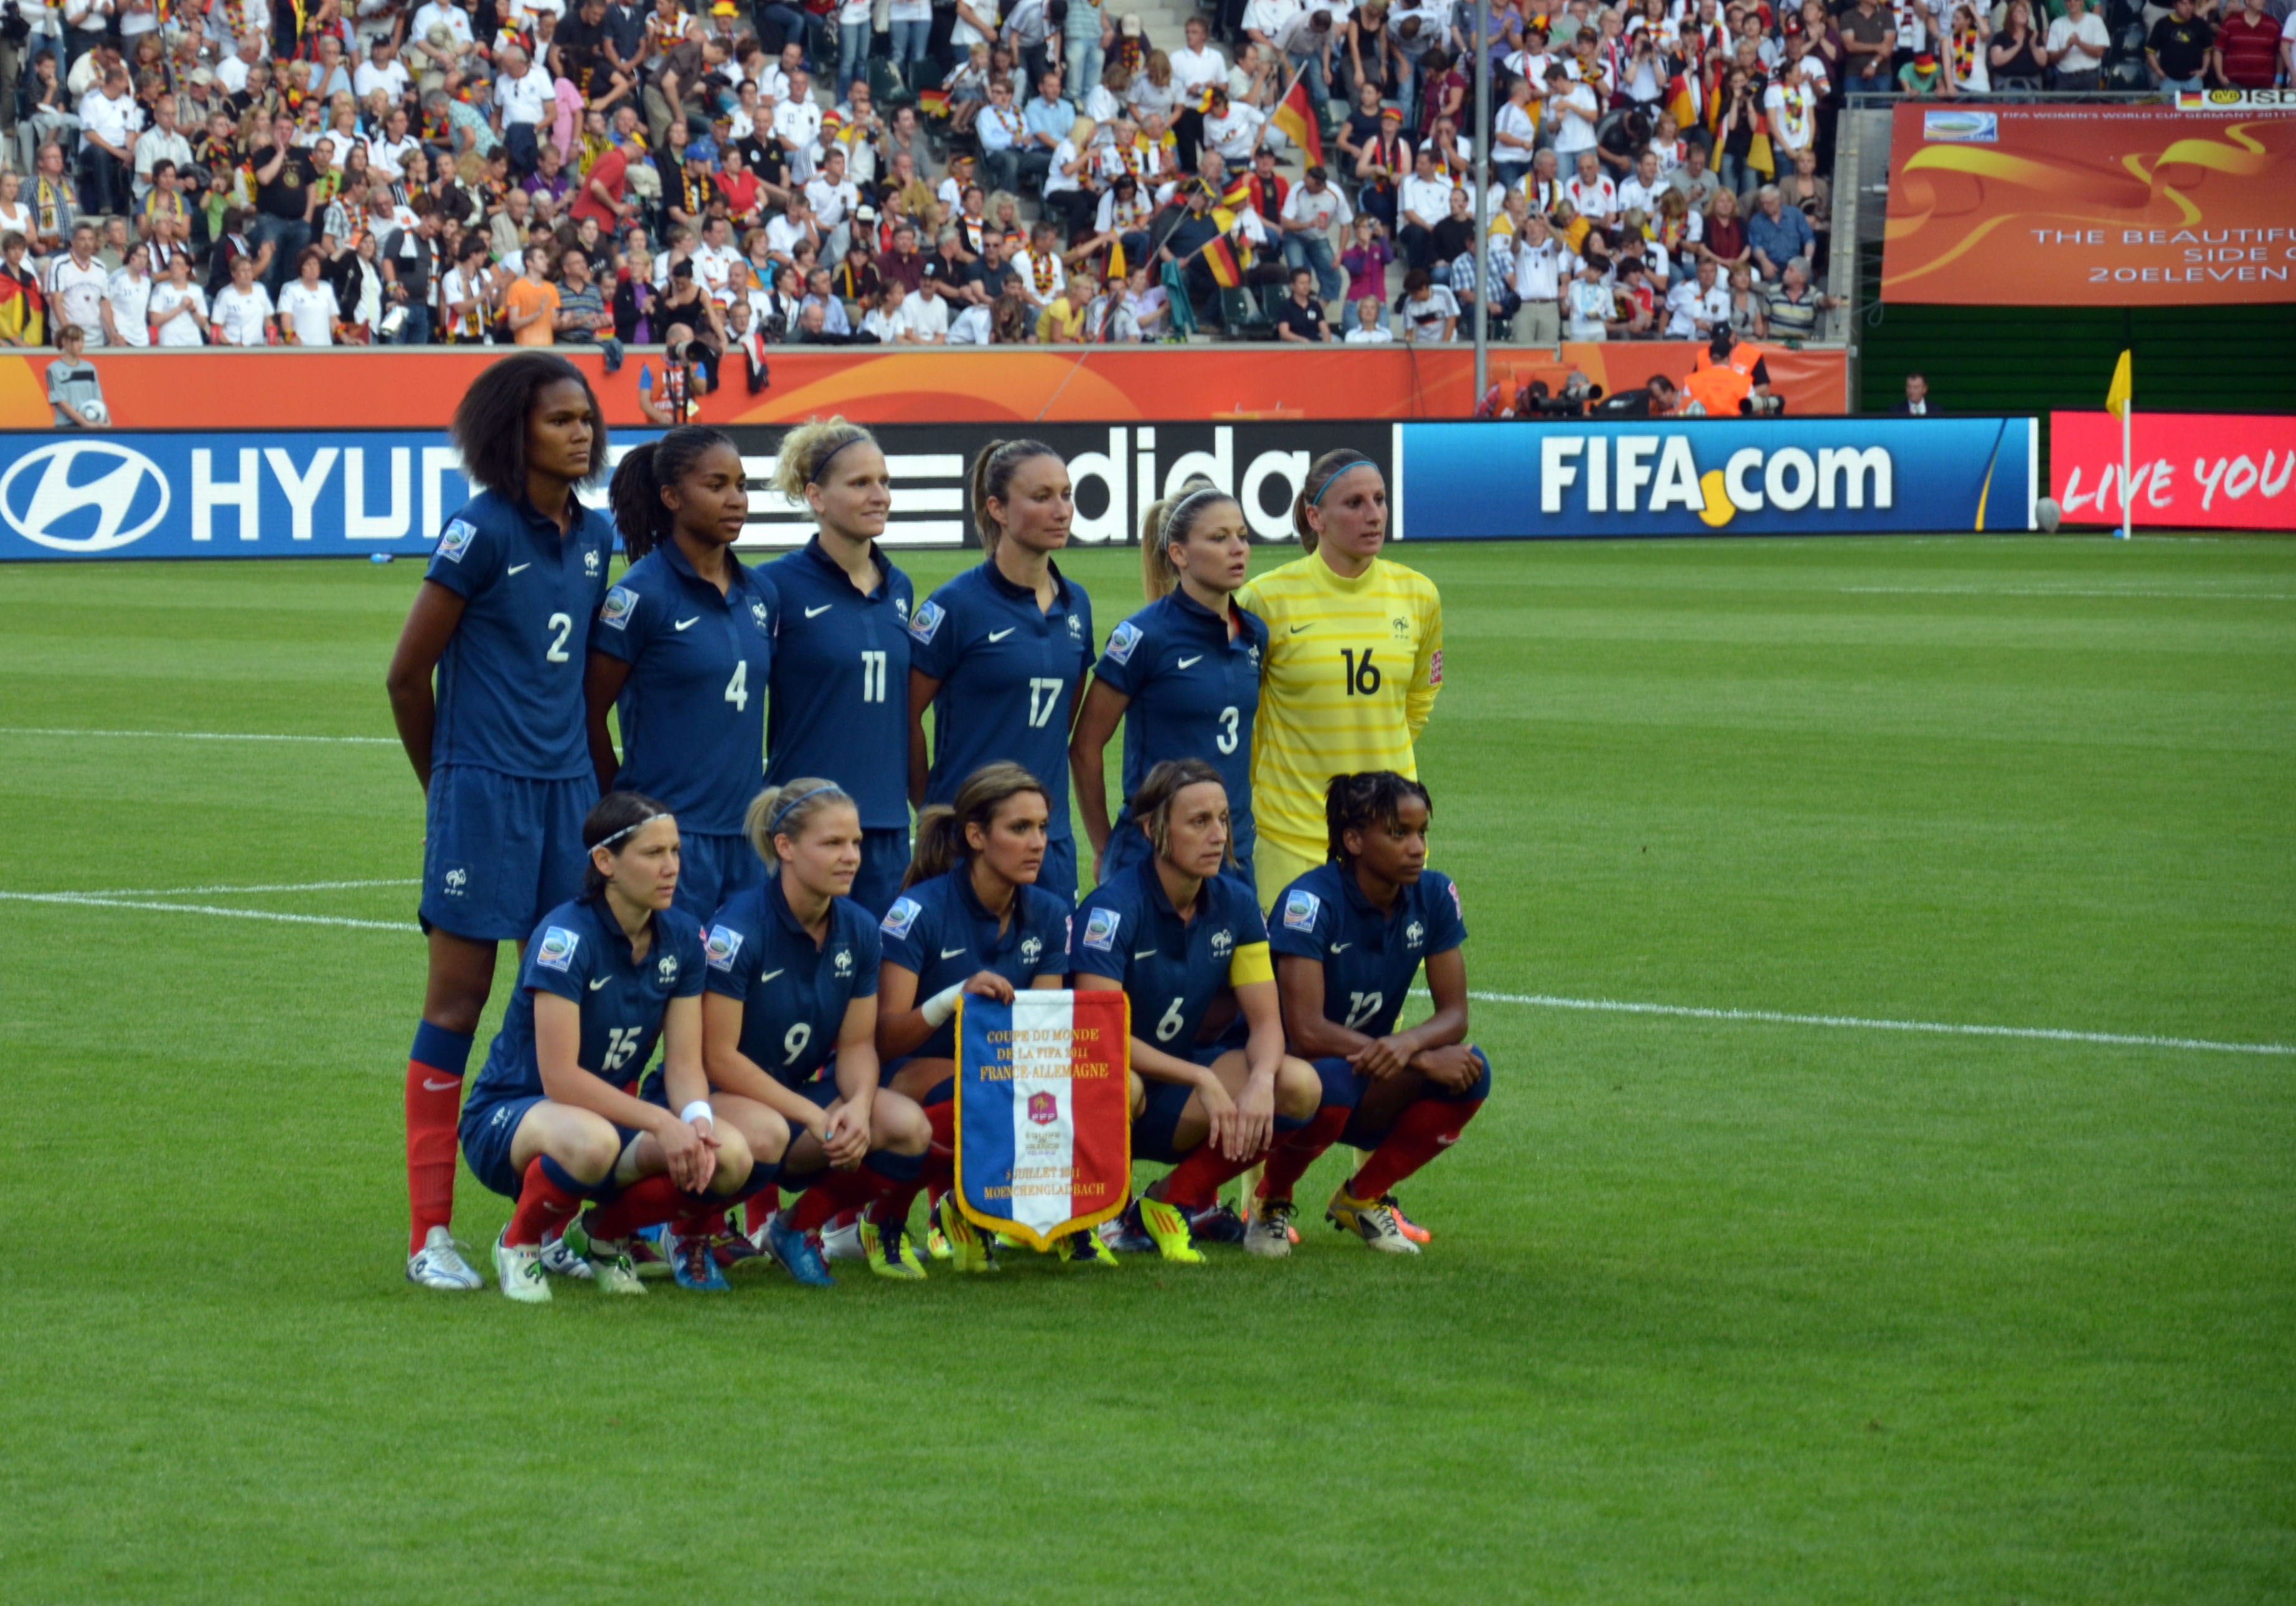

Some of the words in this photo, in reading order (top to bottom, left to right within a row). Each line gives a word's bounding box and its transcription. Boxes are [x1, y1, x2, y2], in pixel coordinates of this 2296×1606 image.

[2030, 229, 2105, 245] THE
[2184, 247, 2267, 262] SIDE
[1066, 426, 1310, 542] dida
[1541, 435, 1892, 527] FIFA.com
[2063, 458, 2175, 514] LIVE
[2194, 448, 2296, 511] YOU
[546, 612, 572, 662] 2
[724, 660, 748, 712] 4
[861, 650, 887, 703] 11
[1340, 647, 1381, 695] 16
[1028, 677, 1064, 728] 17
[1216, 706, 1239, 755] 3
[1155, 997, 1184, 1042] 6
[1344, 992, 1383, 1029] 12
[601, 1026, 642, 1071] 15
[782, 1022, 811, 1066] 9
[987, 1030, 1029, 1043] COUPE
[1032, 1029, 1050, 1041] DU
[1052, 1028, 1099, 1041] MONDE
[997, 1048, 1013, 1061] DE
[1018, 1047, 1033, 1059] LA
[1037, 1046, 1062, 1058] FIFA
[1065, 1046, 1088, 1059] 2011
[979, 1063, 1108, 1082] FRANCE-ALLEMAGNE
[984, 1183, 1105, 1200] MOENCHENGLADBACH
[1013, 1166, 1057, 1179] JUILLET
